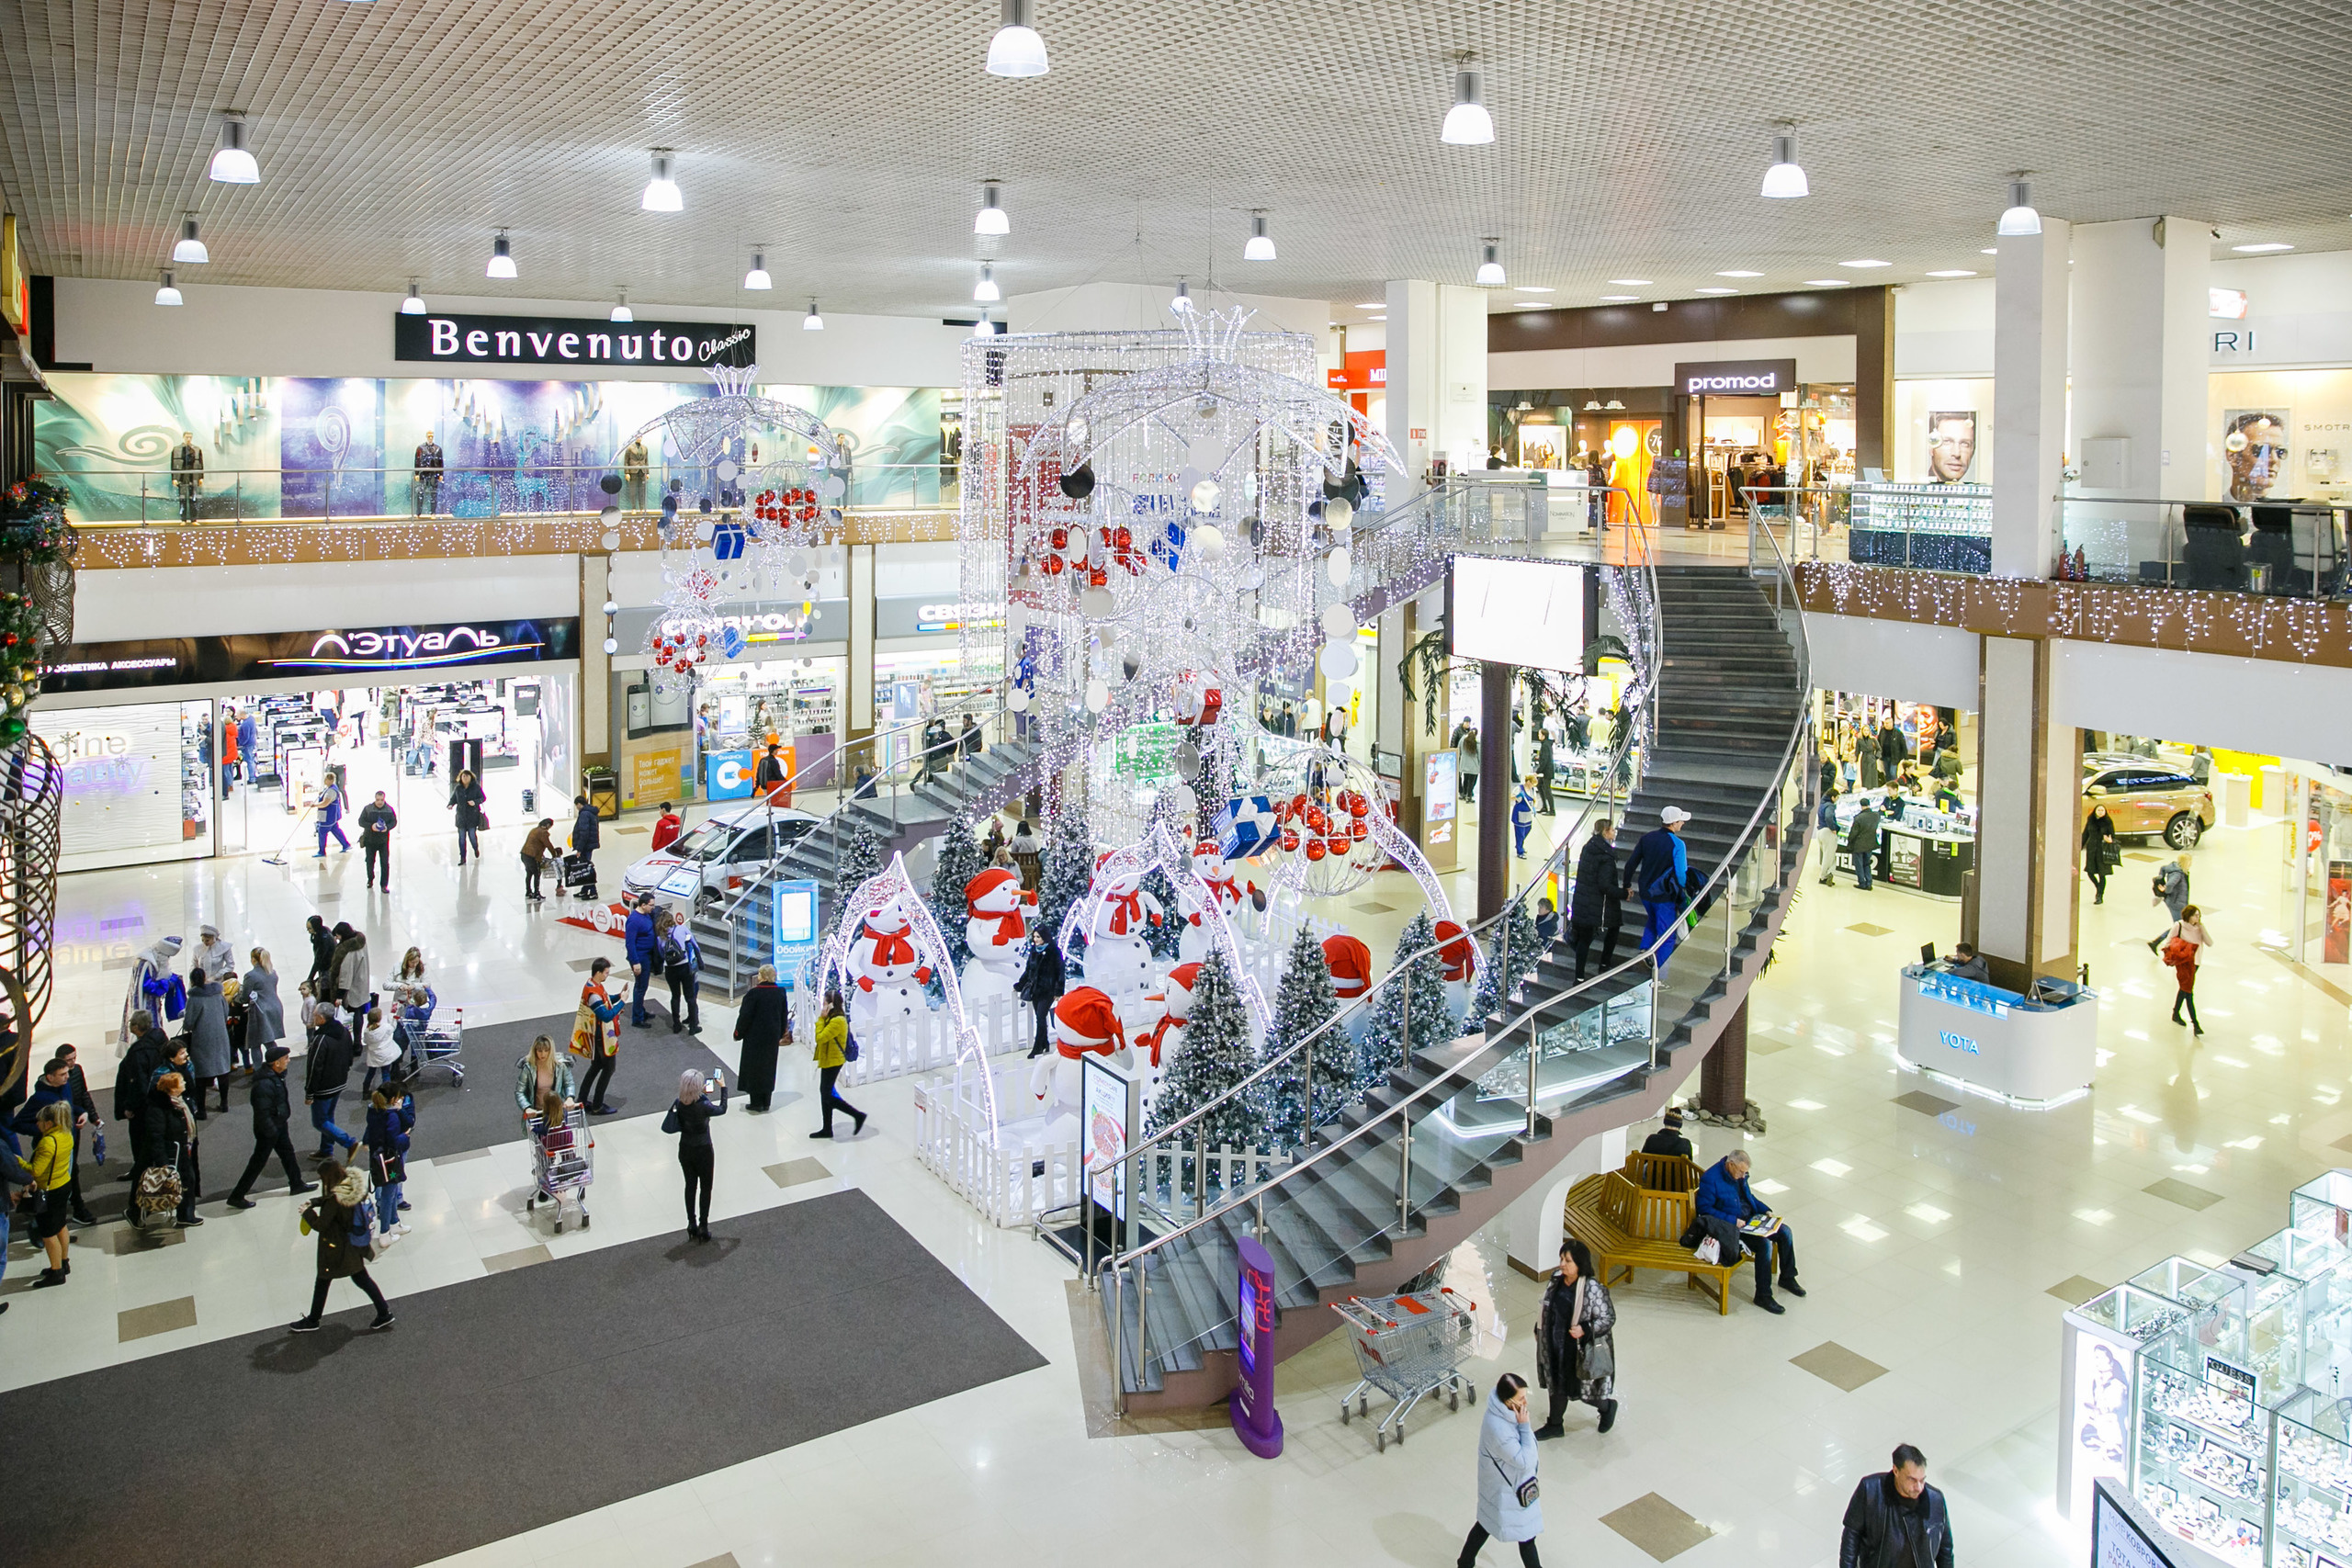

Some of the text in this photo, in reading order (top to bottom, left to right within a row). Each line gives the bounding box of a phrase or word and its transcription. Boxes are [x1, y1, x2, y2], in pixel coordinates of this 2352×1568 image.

[428, 319, 752, 363] Benvenuto Classic
[1689, 373, 1775, 392] promod
[110, 658, 176, 671] АКСЕССУАРЫ
[49, 732, 127, 766] gine
[68, 758, 145, 788] auty
[1939, 1030, 1980, 1055] YOTA
[2211, 1360, 2251, 1384] GUESS
